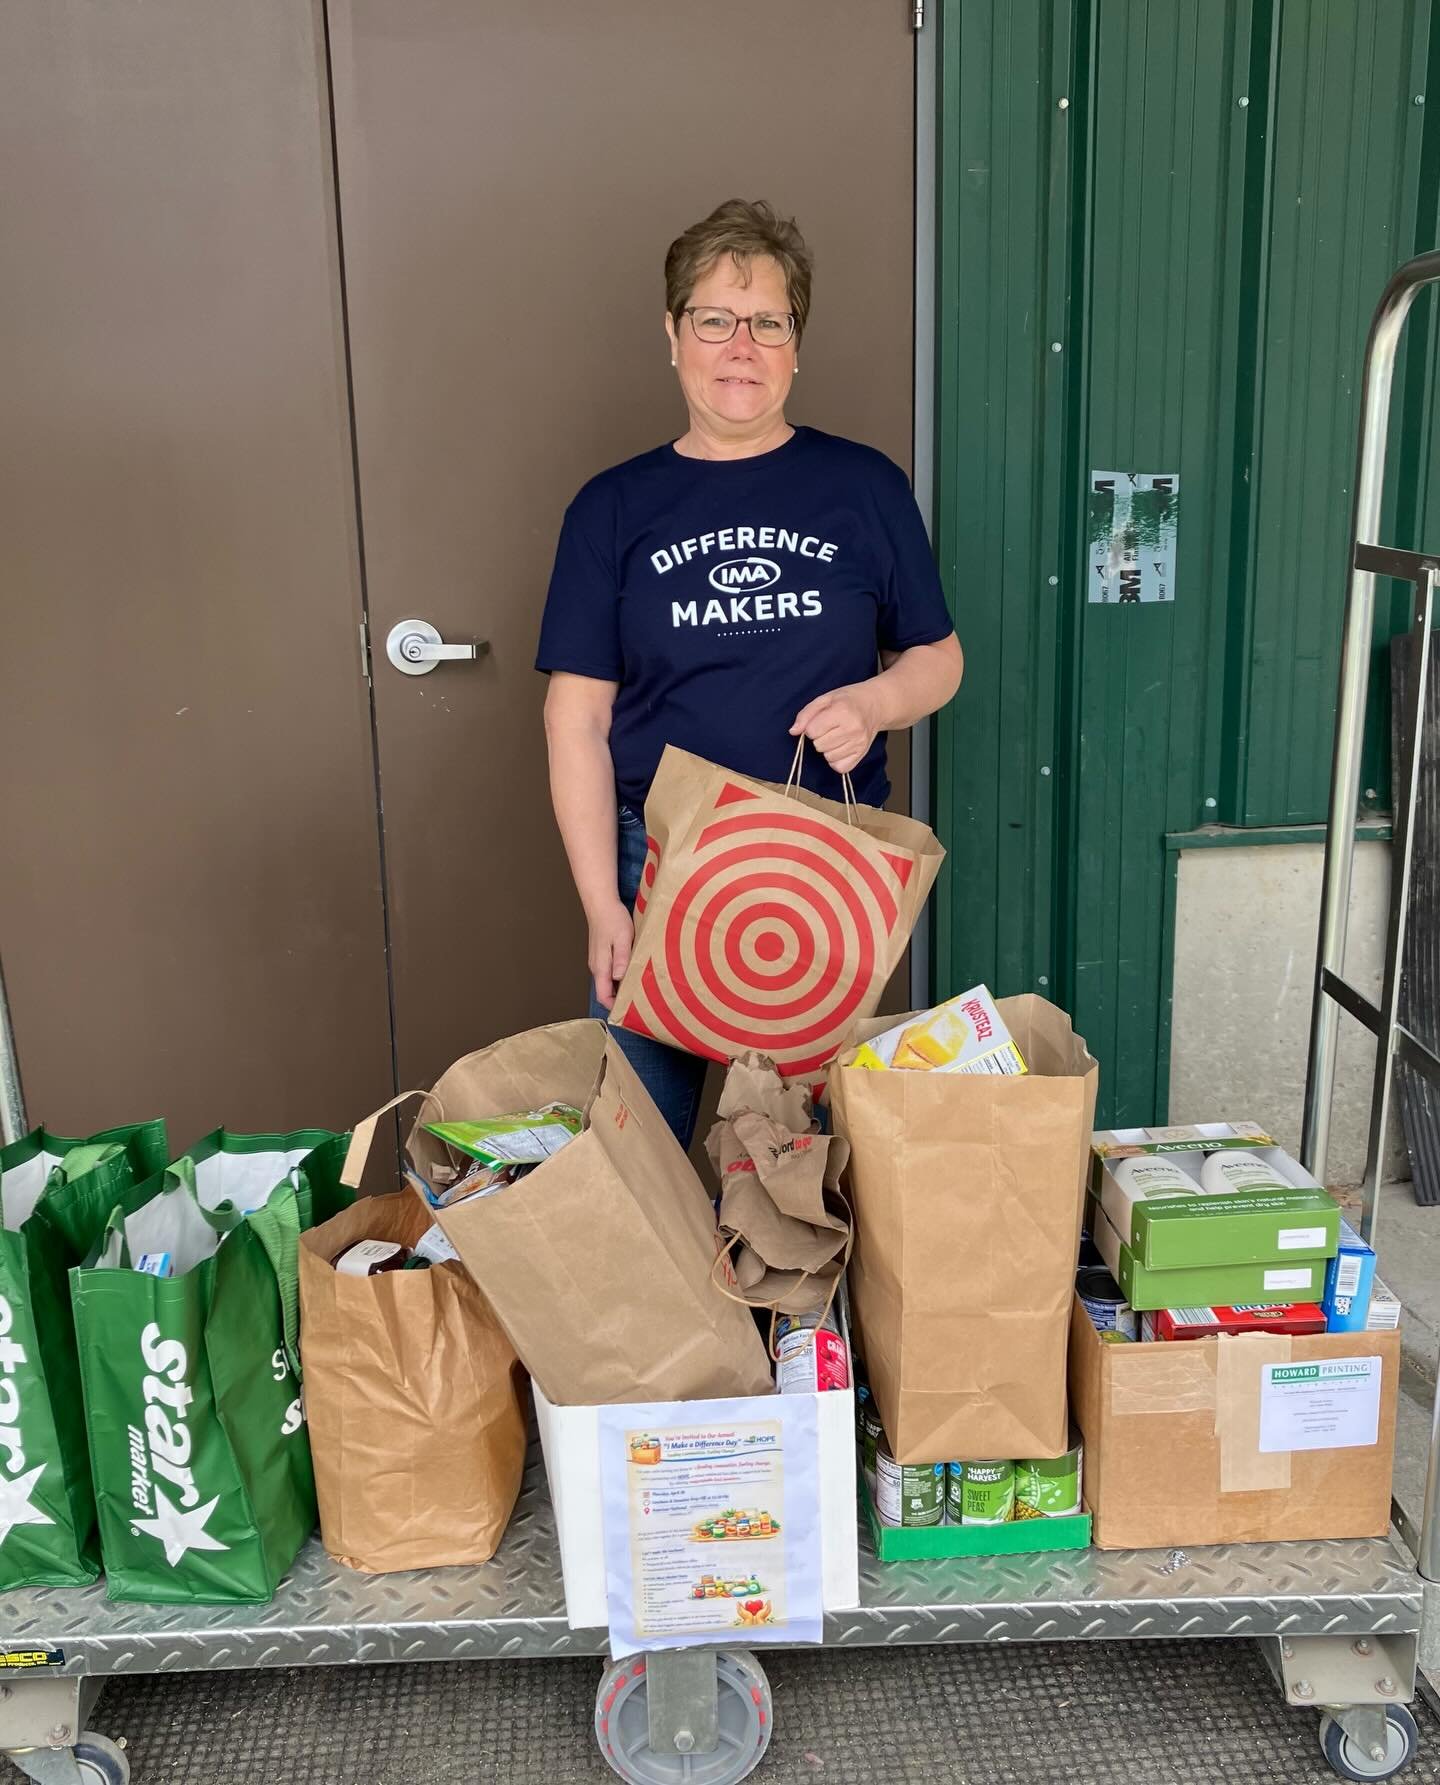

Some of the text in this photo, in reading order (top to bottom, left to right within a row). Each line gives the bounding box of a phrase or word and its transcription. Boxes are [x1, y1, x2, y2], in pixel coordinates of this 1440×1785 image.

[651, 526, 838, 574] DIFFERENCE
[721, 565, 770, 584] IMA
[671, 590, 823, 627] MAKERS
[961, 998, 993, 1042] KRUSTEAZ
[1156, 1141, 1223, 1151] Aveeno
[1205, 1205, 1223, 1213] help
[1224, 1203, 1255, 1211] prevent
[1274, 1363, 1368, 1378] HOWARD PRINTING
[140, 1322, 200, 1507] star
[671, 1441, 688, 1449] Make
[695, 1439, 725, 1448] Difference
[127, 1424, 154, 1515] market
[969, 1467, 995, 1475] HAPPY
[967, 1473, 1001, 1482] HARVEST
[967, 1490, 991, 1502] SWEET
[967, 1501, 985, 1513] PEAS
